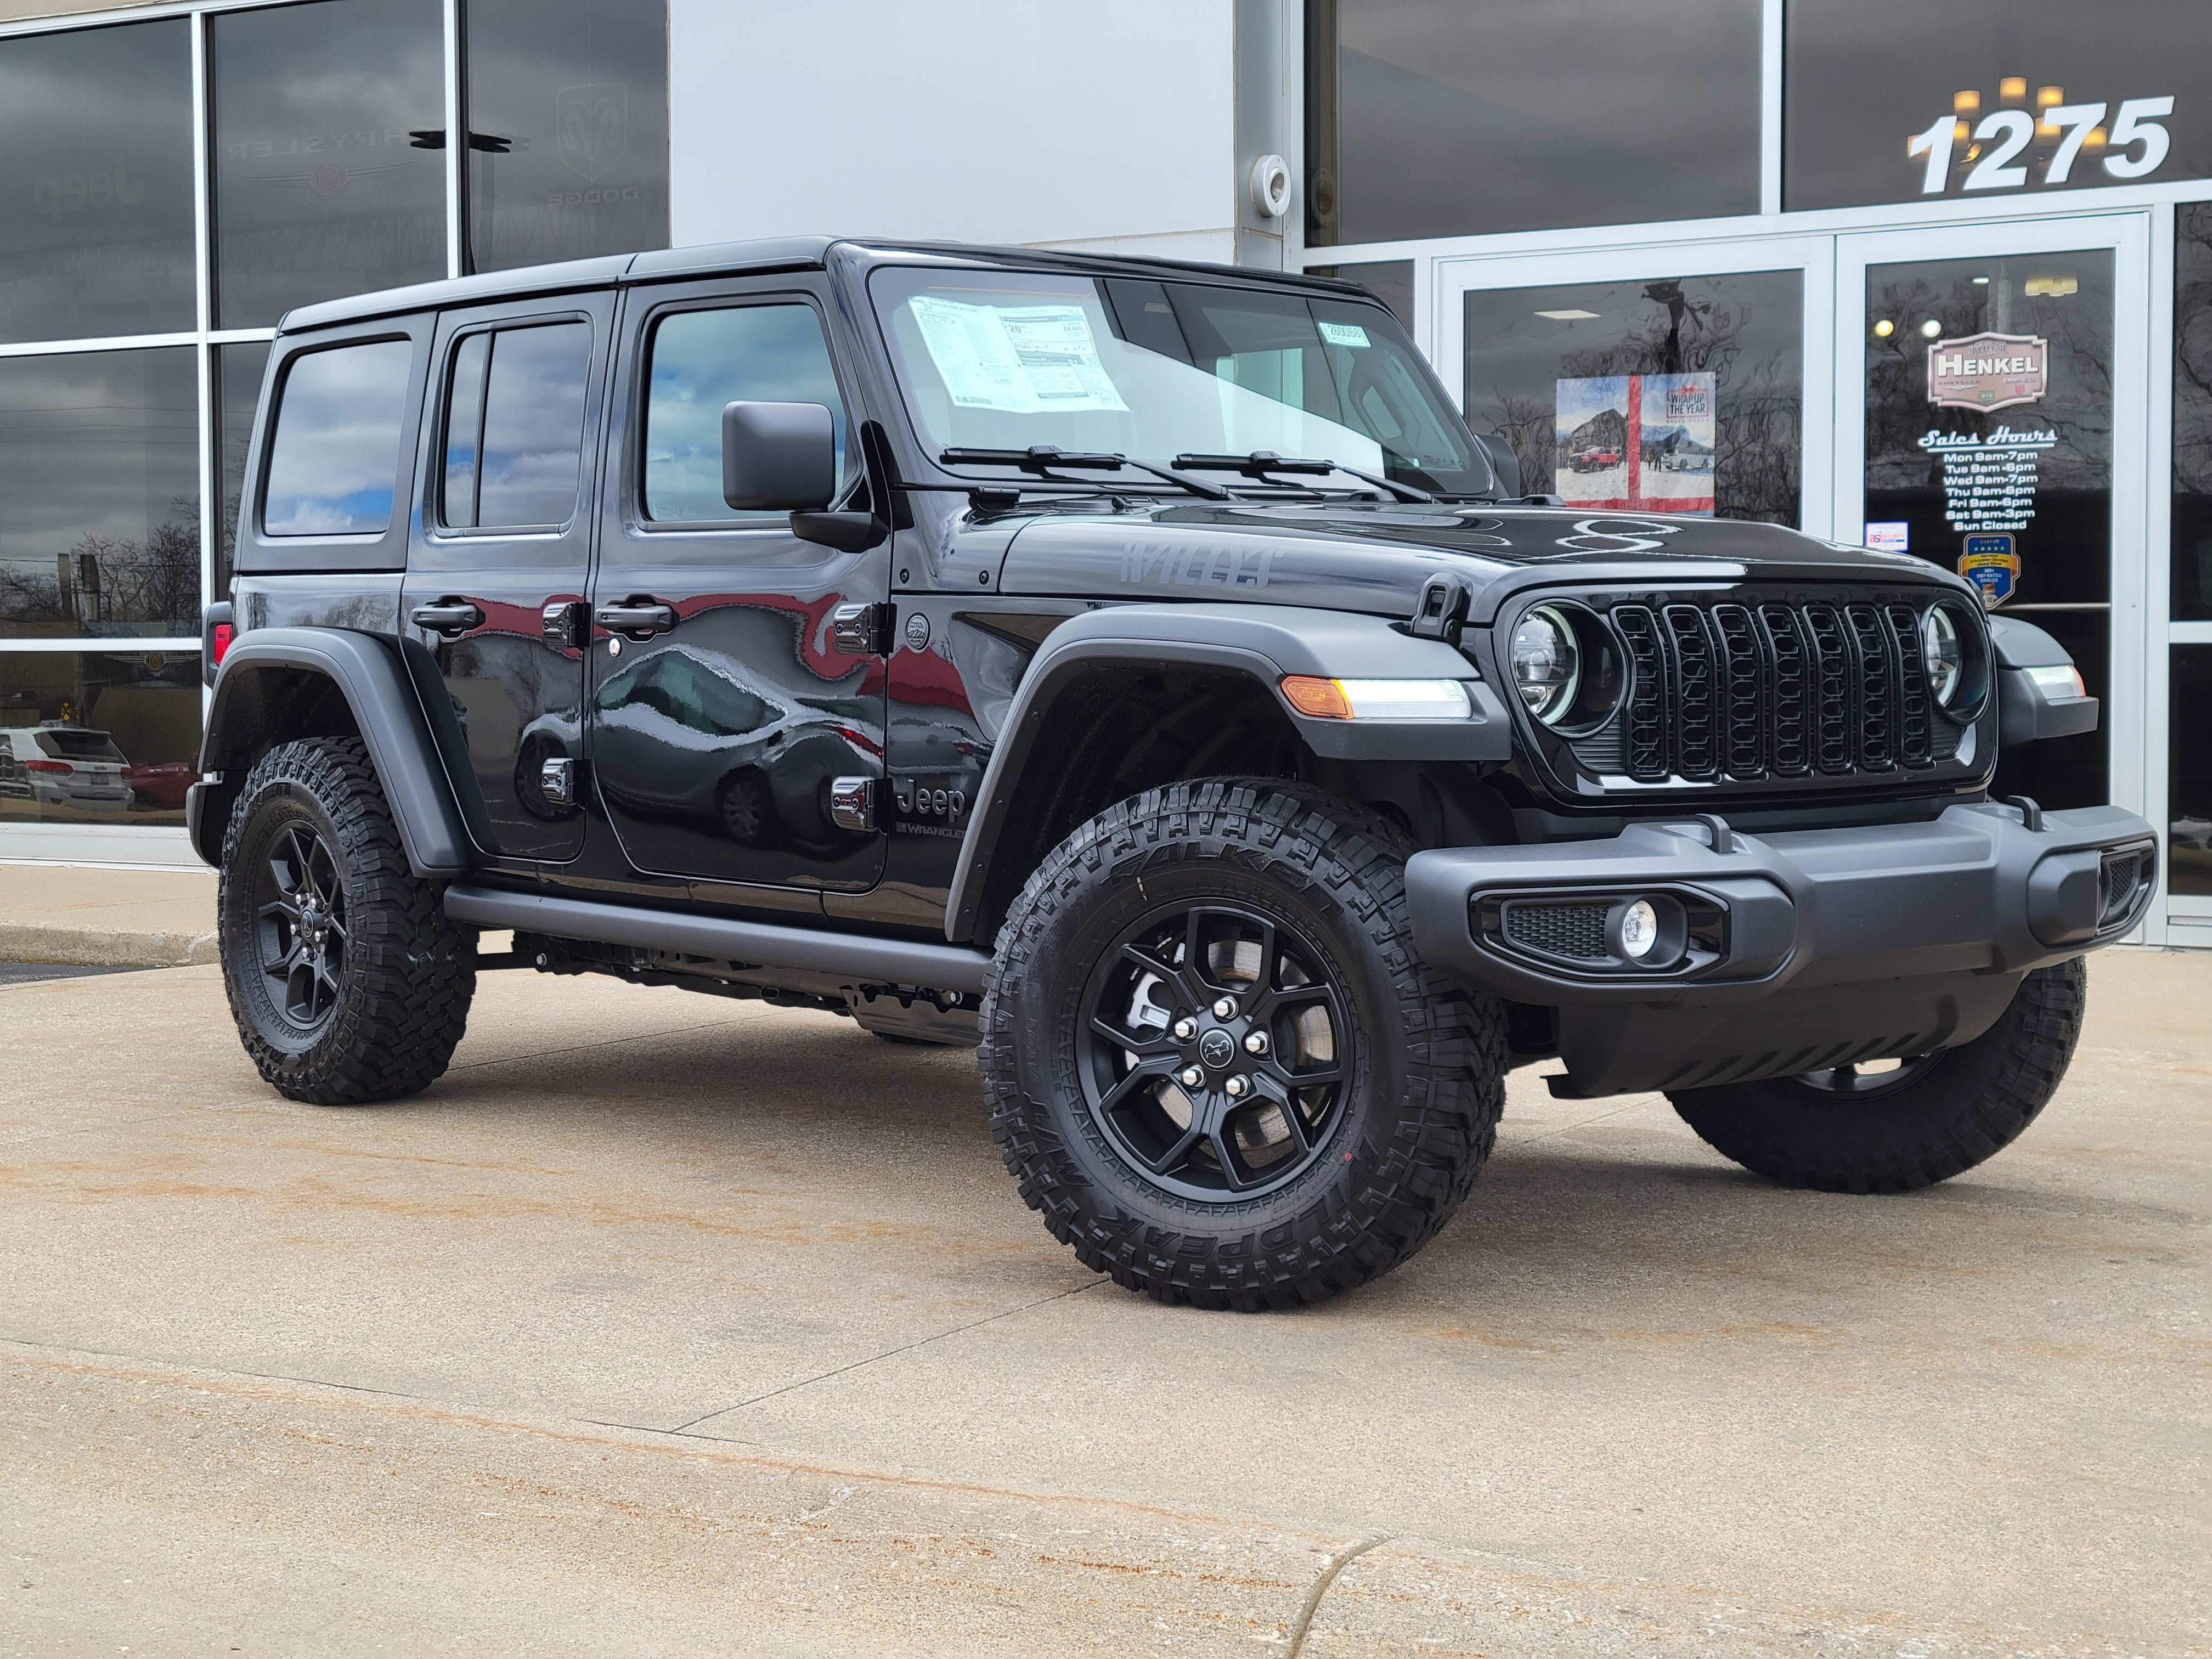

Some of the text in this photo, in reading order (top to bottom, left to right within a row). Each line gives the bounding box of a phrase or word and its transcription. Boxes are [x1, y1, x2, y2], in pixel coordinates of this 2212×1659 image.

[1909, 95, 2175, 194] 1275
[1008, 324, 1022, 334] 20
[1328, 325, 1361, 338] 260068
[1938, 354, 2039, 377] HENKEL
[1671, 393, 1704, 404] WRAP UP
[1671, 403, 1705, 414] THE YEAR
[1918, 425, 2058, 447] Sales Hours
[1944, 452, 2038, 462] Mon 9am-7pm
[1946, 465, 1968, 474] Tue
[1971, 464, 2000, 473] 9am
[1943, 474, 2038, 485] Wed 9am-7pm
[1945, 486, 2035, 496] Thu 9am-6pm
[1949, 497, 2032, 508] Fri 9am-6pm
[1945, 509, 2035, 520] Sat 9am-3pm
[1954, 520, 2027, 531] Sun Closed
[898, 778, 965, 823] Jeep
[1099, 1135, 1379, 1259] WILDPEAK
